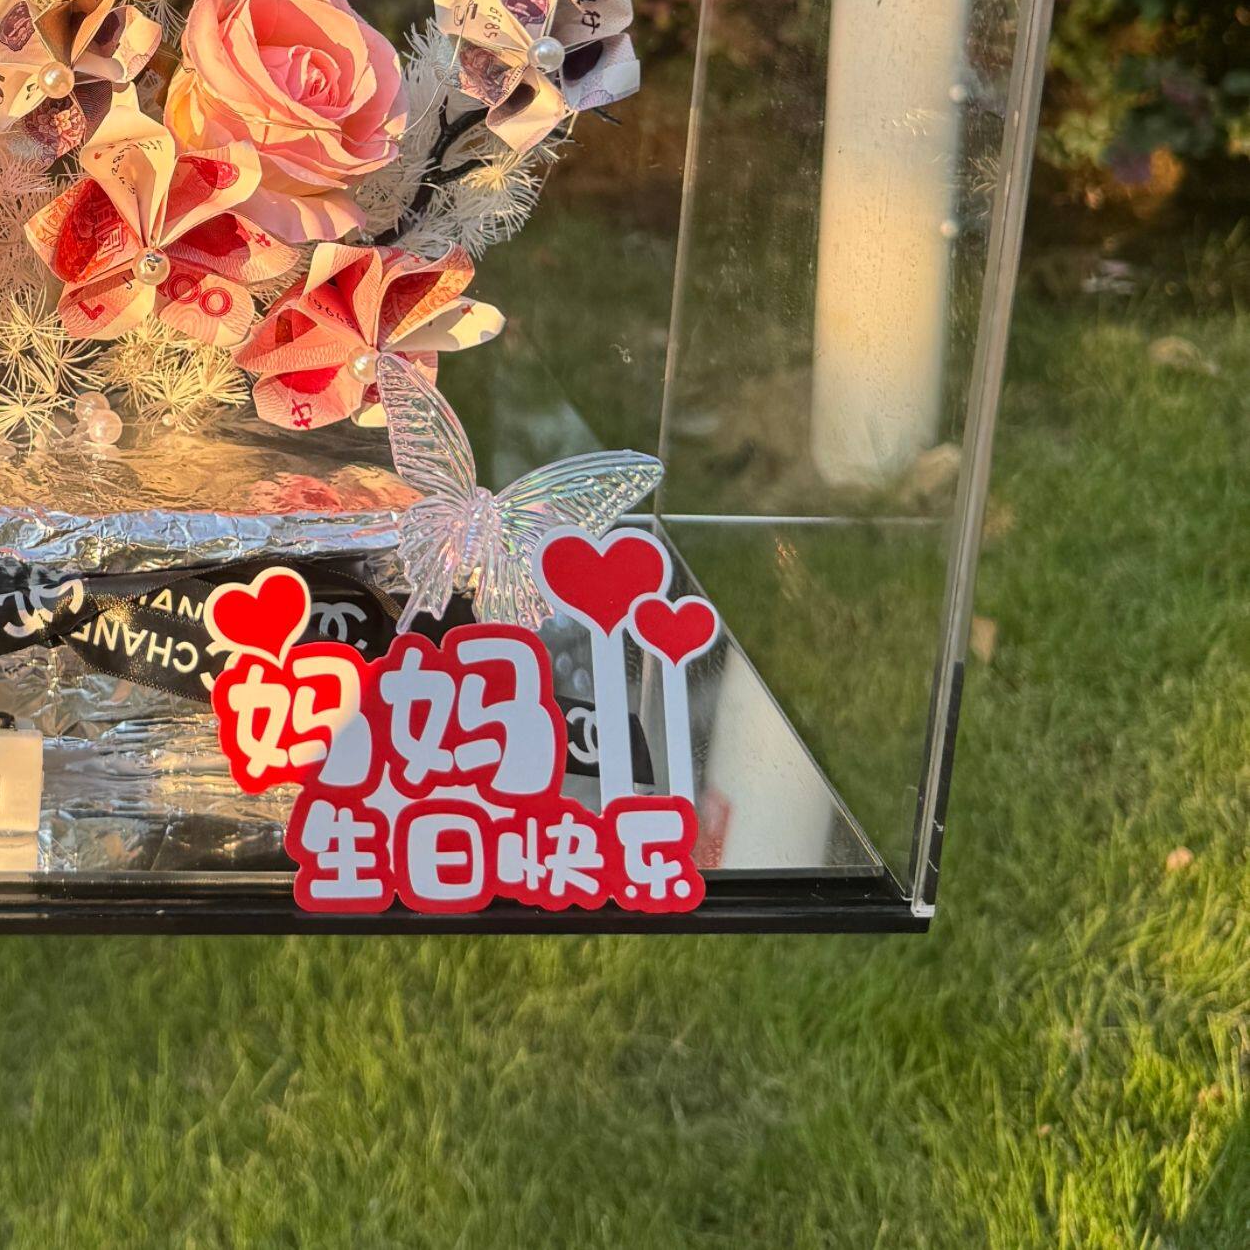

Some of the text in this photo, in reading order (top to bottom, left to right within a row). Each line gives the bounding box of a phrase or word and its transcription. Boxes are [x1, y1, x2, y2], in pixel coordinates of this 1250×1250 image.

[228, 636, 557, 796] 妈妈
[301, 799, 692, 901] 生日快乐
